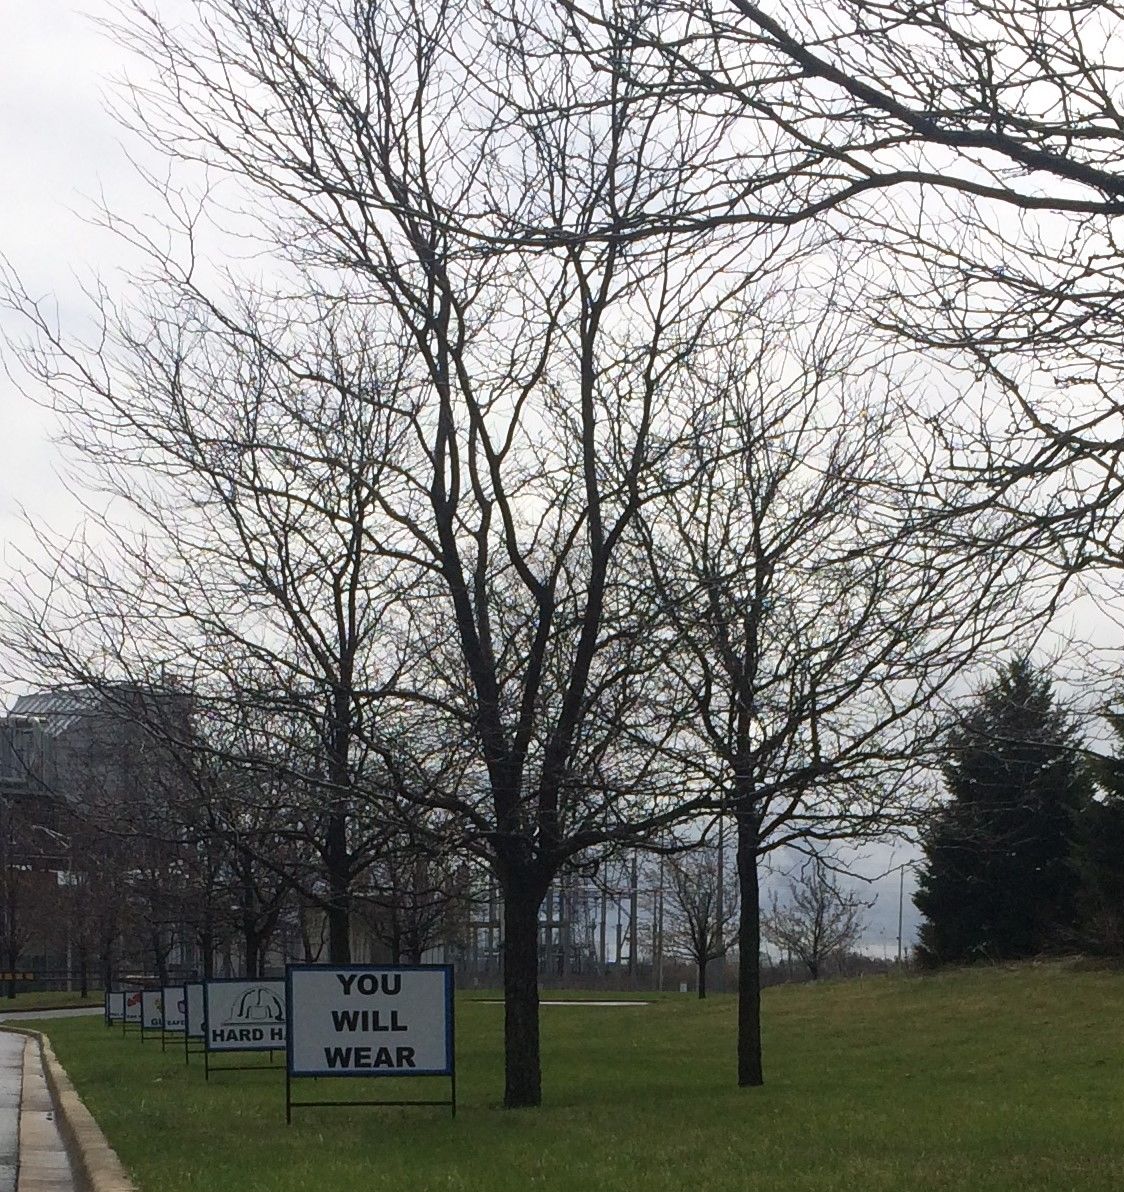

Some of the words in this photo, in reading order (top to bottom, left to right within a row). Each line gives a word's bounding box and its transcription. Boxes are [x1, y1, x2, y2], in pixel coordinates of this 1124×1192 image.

[335, 973, 402, 996] YOU
[330, 1010, 409, 1033] WILL
[212, 1028, 264, 1042] HARD
[324, 1046, 417, 1069] WEAR
